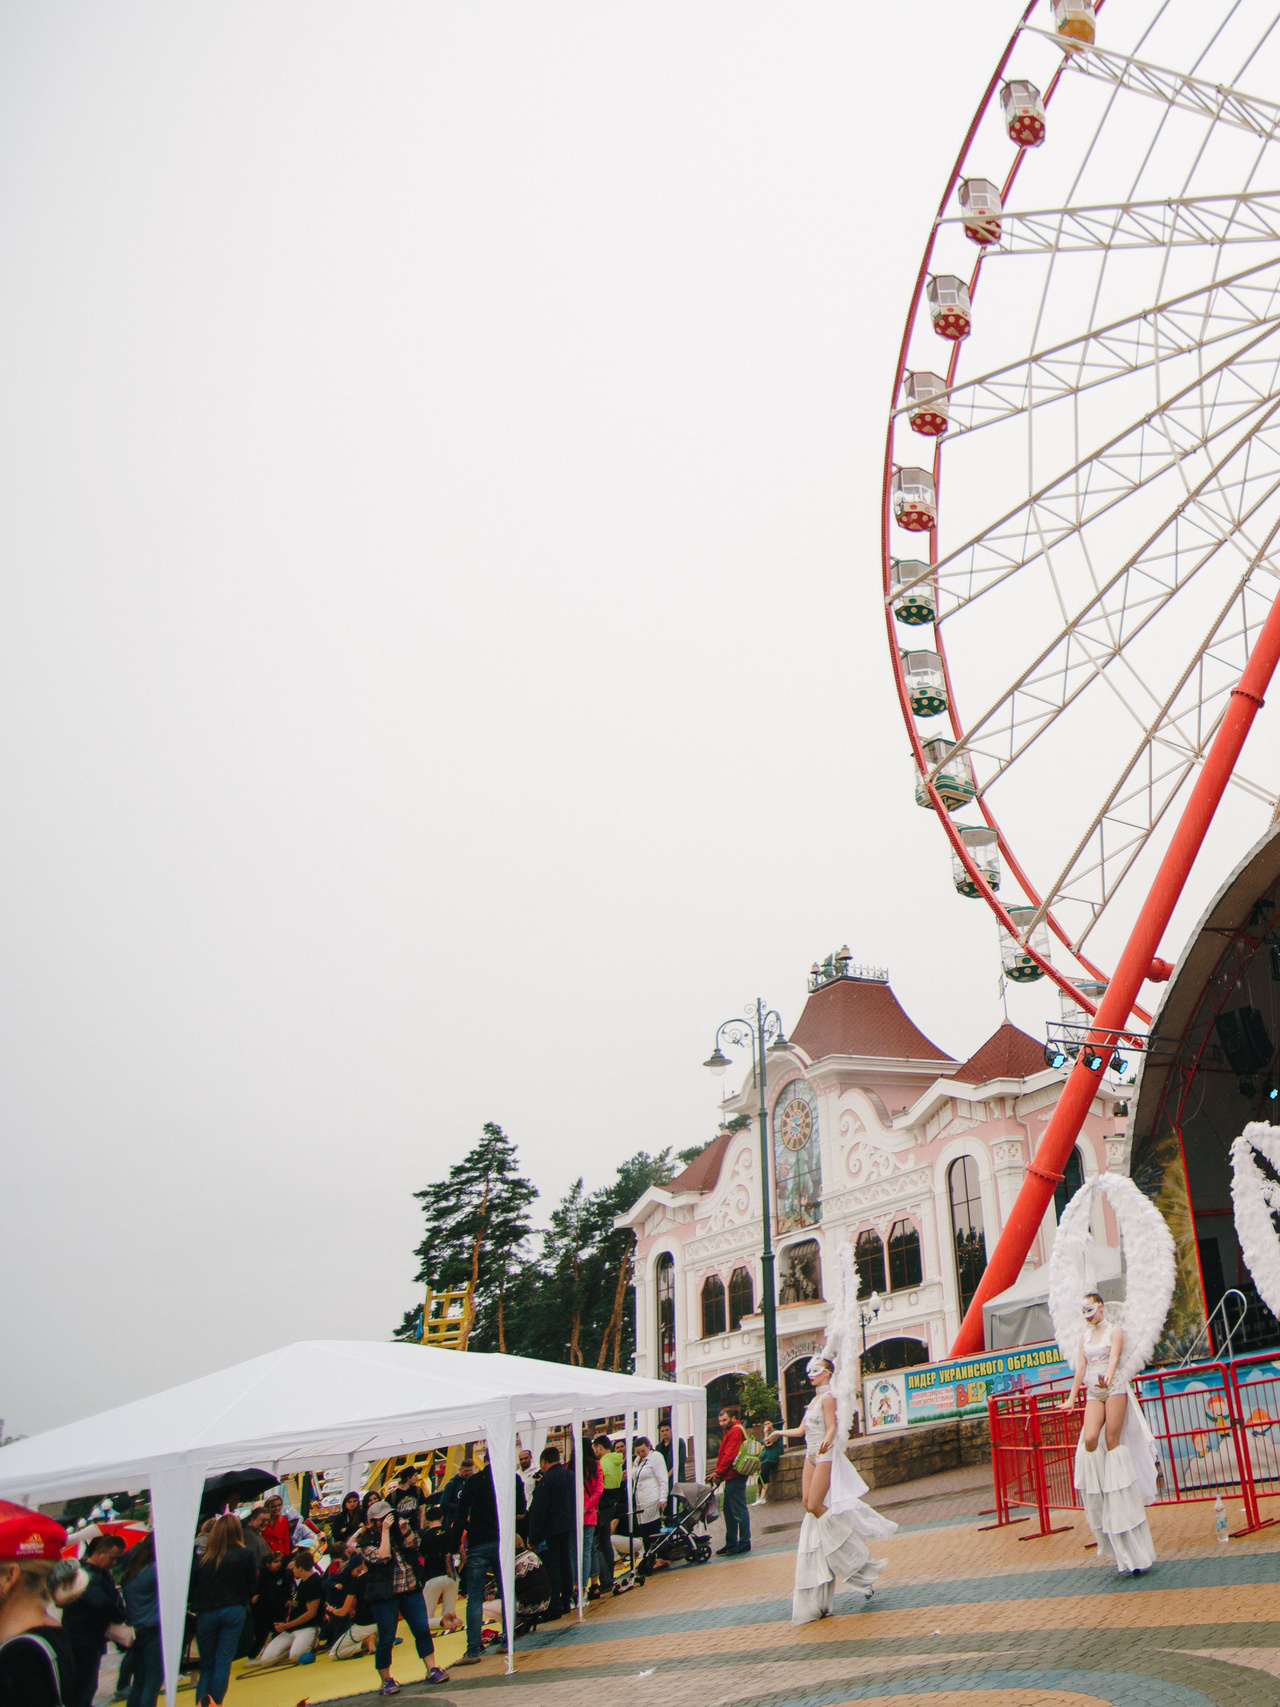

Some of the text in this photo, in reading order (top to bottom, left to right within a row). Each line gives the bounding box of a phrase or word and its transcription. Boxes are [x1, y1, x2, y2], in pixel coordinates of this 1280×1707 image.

[907, 1371, 937, 1390] ЛИДЕР
[939, 1359, 1004, 1383] УКРАИНСКОГО
[955, 1373, 1033, 1409] ВЕРЕСЕНЬ
